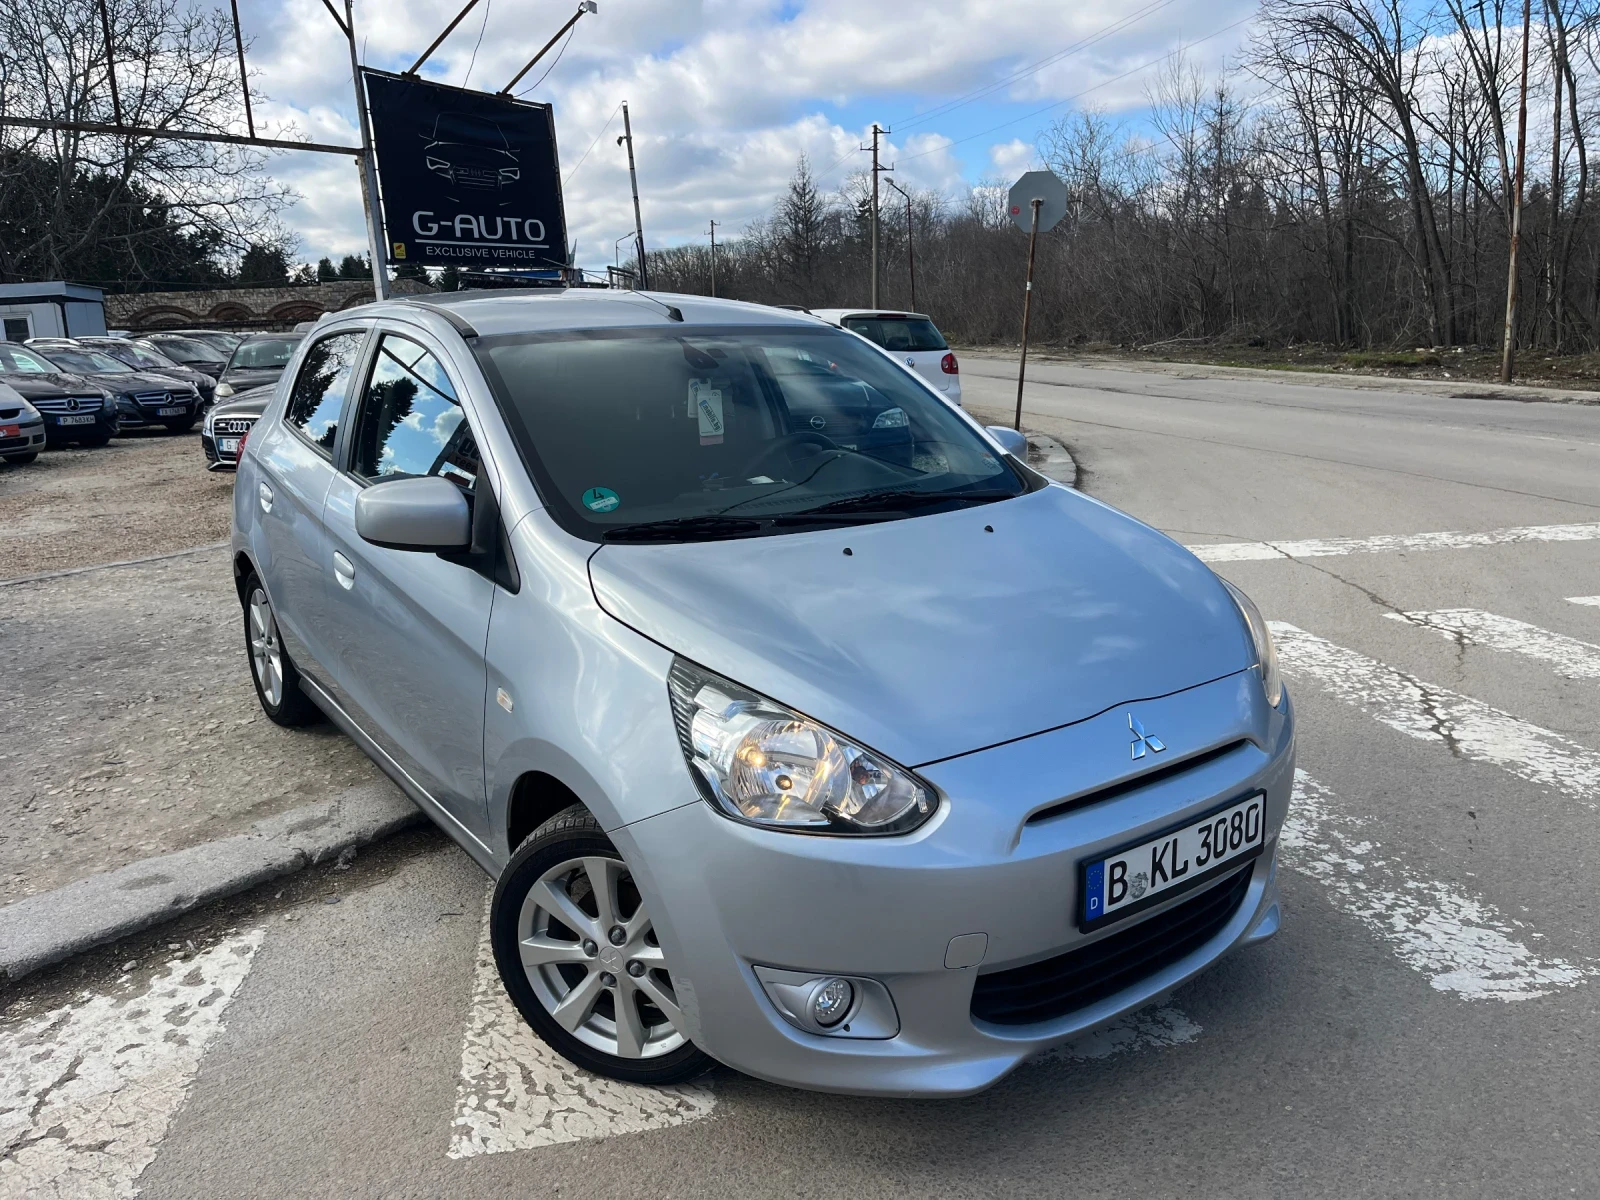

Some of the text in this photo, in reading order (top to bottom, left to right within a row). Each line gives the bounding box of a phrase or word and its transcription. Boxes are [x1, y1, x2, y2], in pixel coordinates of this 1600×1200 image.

[412, 210, 546, 241] G-AUTO
[426, 246, 535, 259] EXCLUSIVE VEHICLE
[702, 404, 721, 431] mobile.bg
[1107, 803, 1259, 906] B KL 3080
[1090, 897, 1098, 910] D
